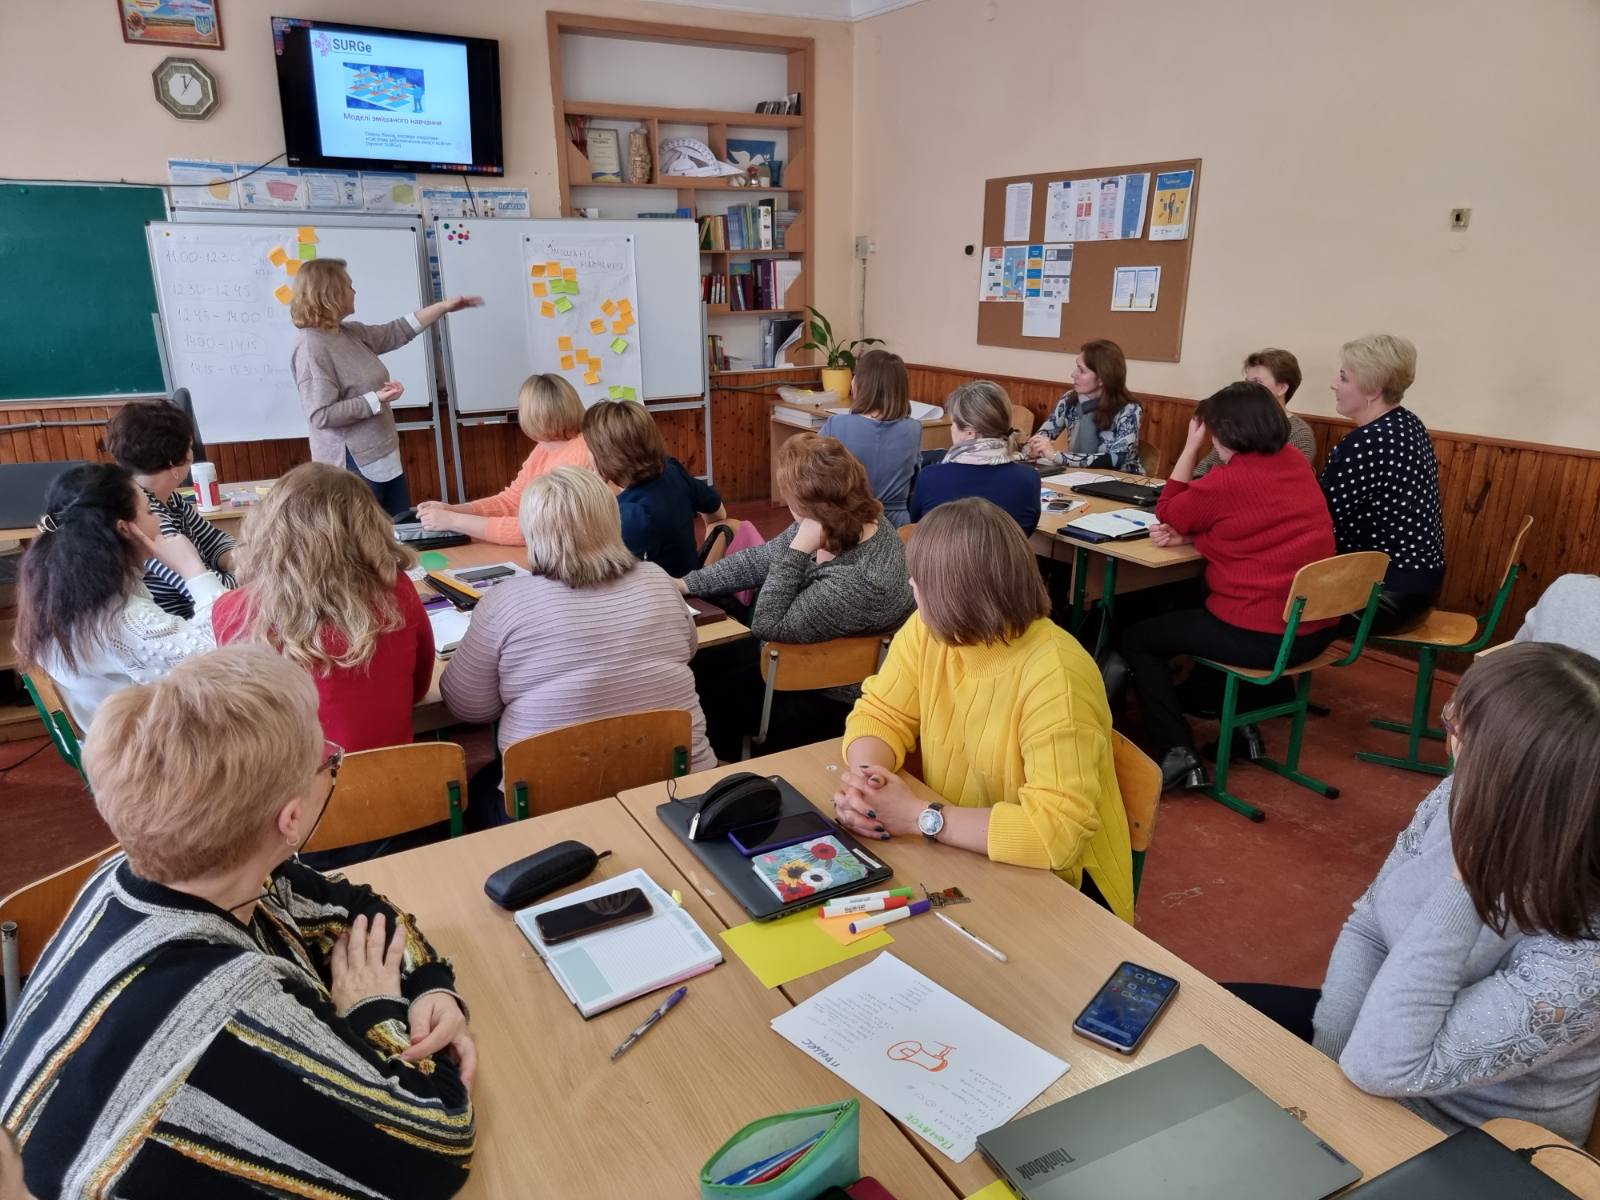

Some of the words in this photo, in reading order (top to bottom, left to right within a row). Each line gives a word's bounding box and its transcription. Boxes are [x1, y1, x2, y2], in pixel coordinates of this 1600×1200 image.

[332, 38, 372, 53] SURGe
[343, 113, 371, 121] Моделі
[1015, 1147, 1076, 1181] ThinkBook
